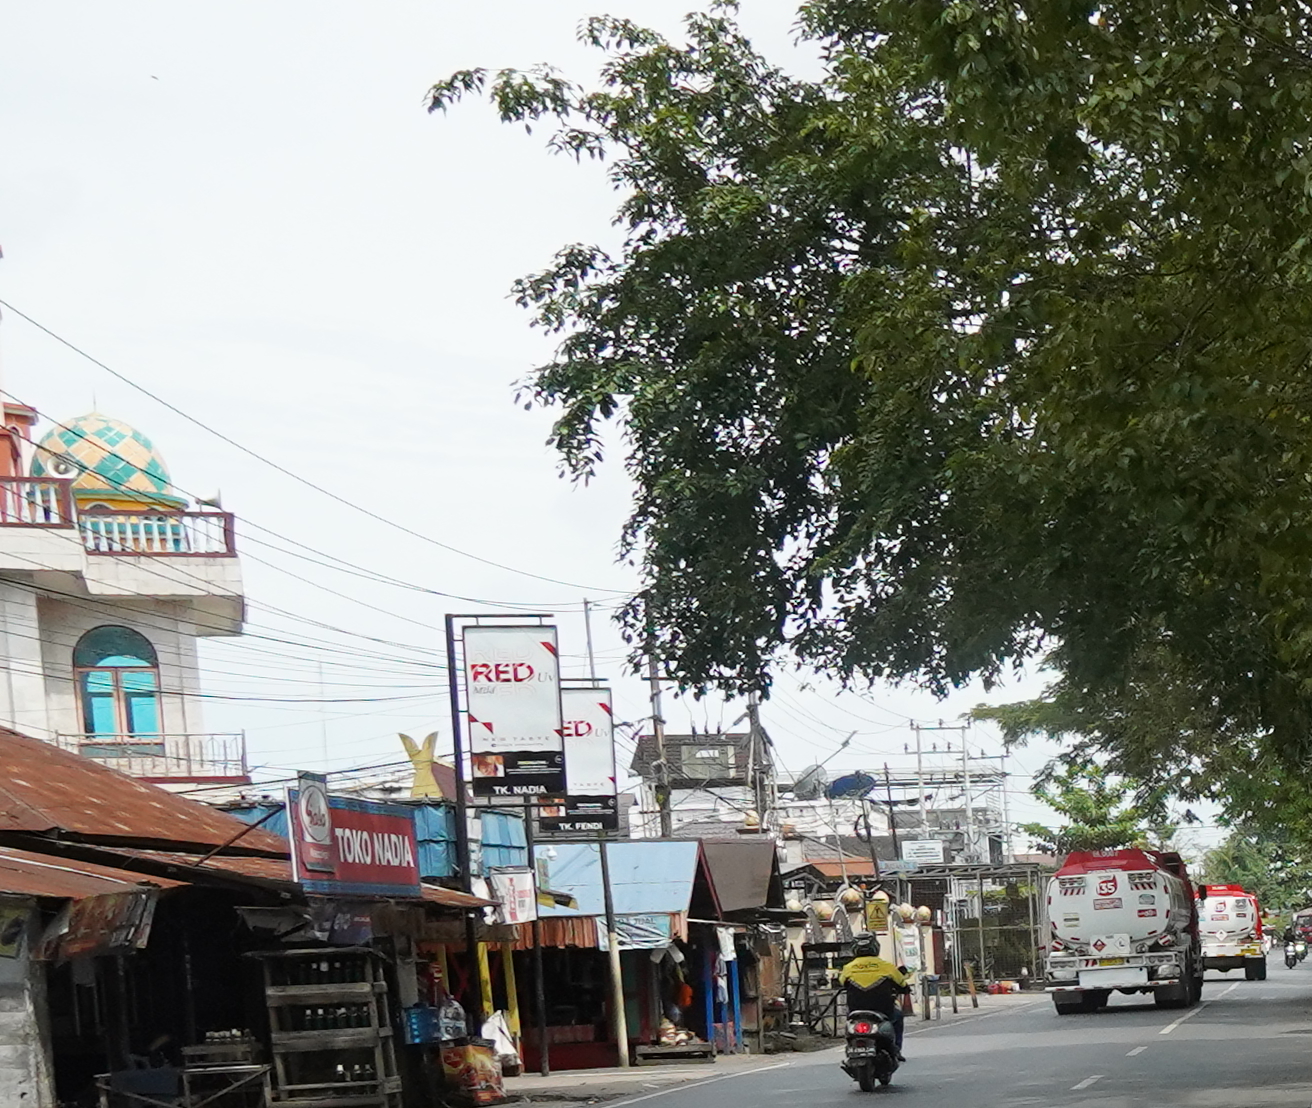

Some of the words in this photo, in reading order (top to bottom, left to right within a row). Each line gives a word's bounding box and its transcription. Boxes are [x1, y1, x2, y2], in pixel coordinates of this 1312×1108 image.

[470, 663, 535, 683] RED
[562, 720, 593, 737] ED
[493, 786, 511, 795] TK.
[513, 784, 548, 794] NADIA
[575, 821, 603, 830] FENDI
[335, 827, 371, 865] TOKO
[374, 833, 415, 868] NADIA
